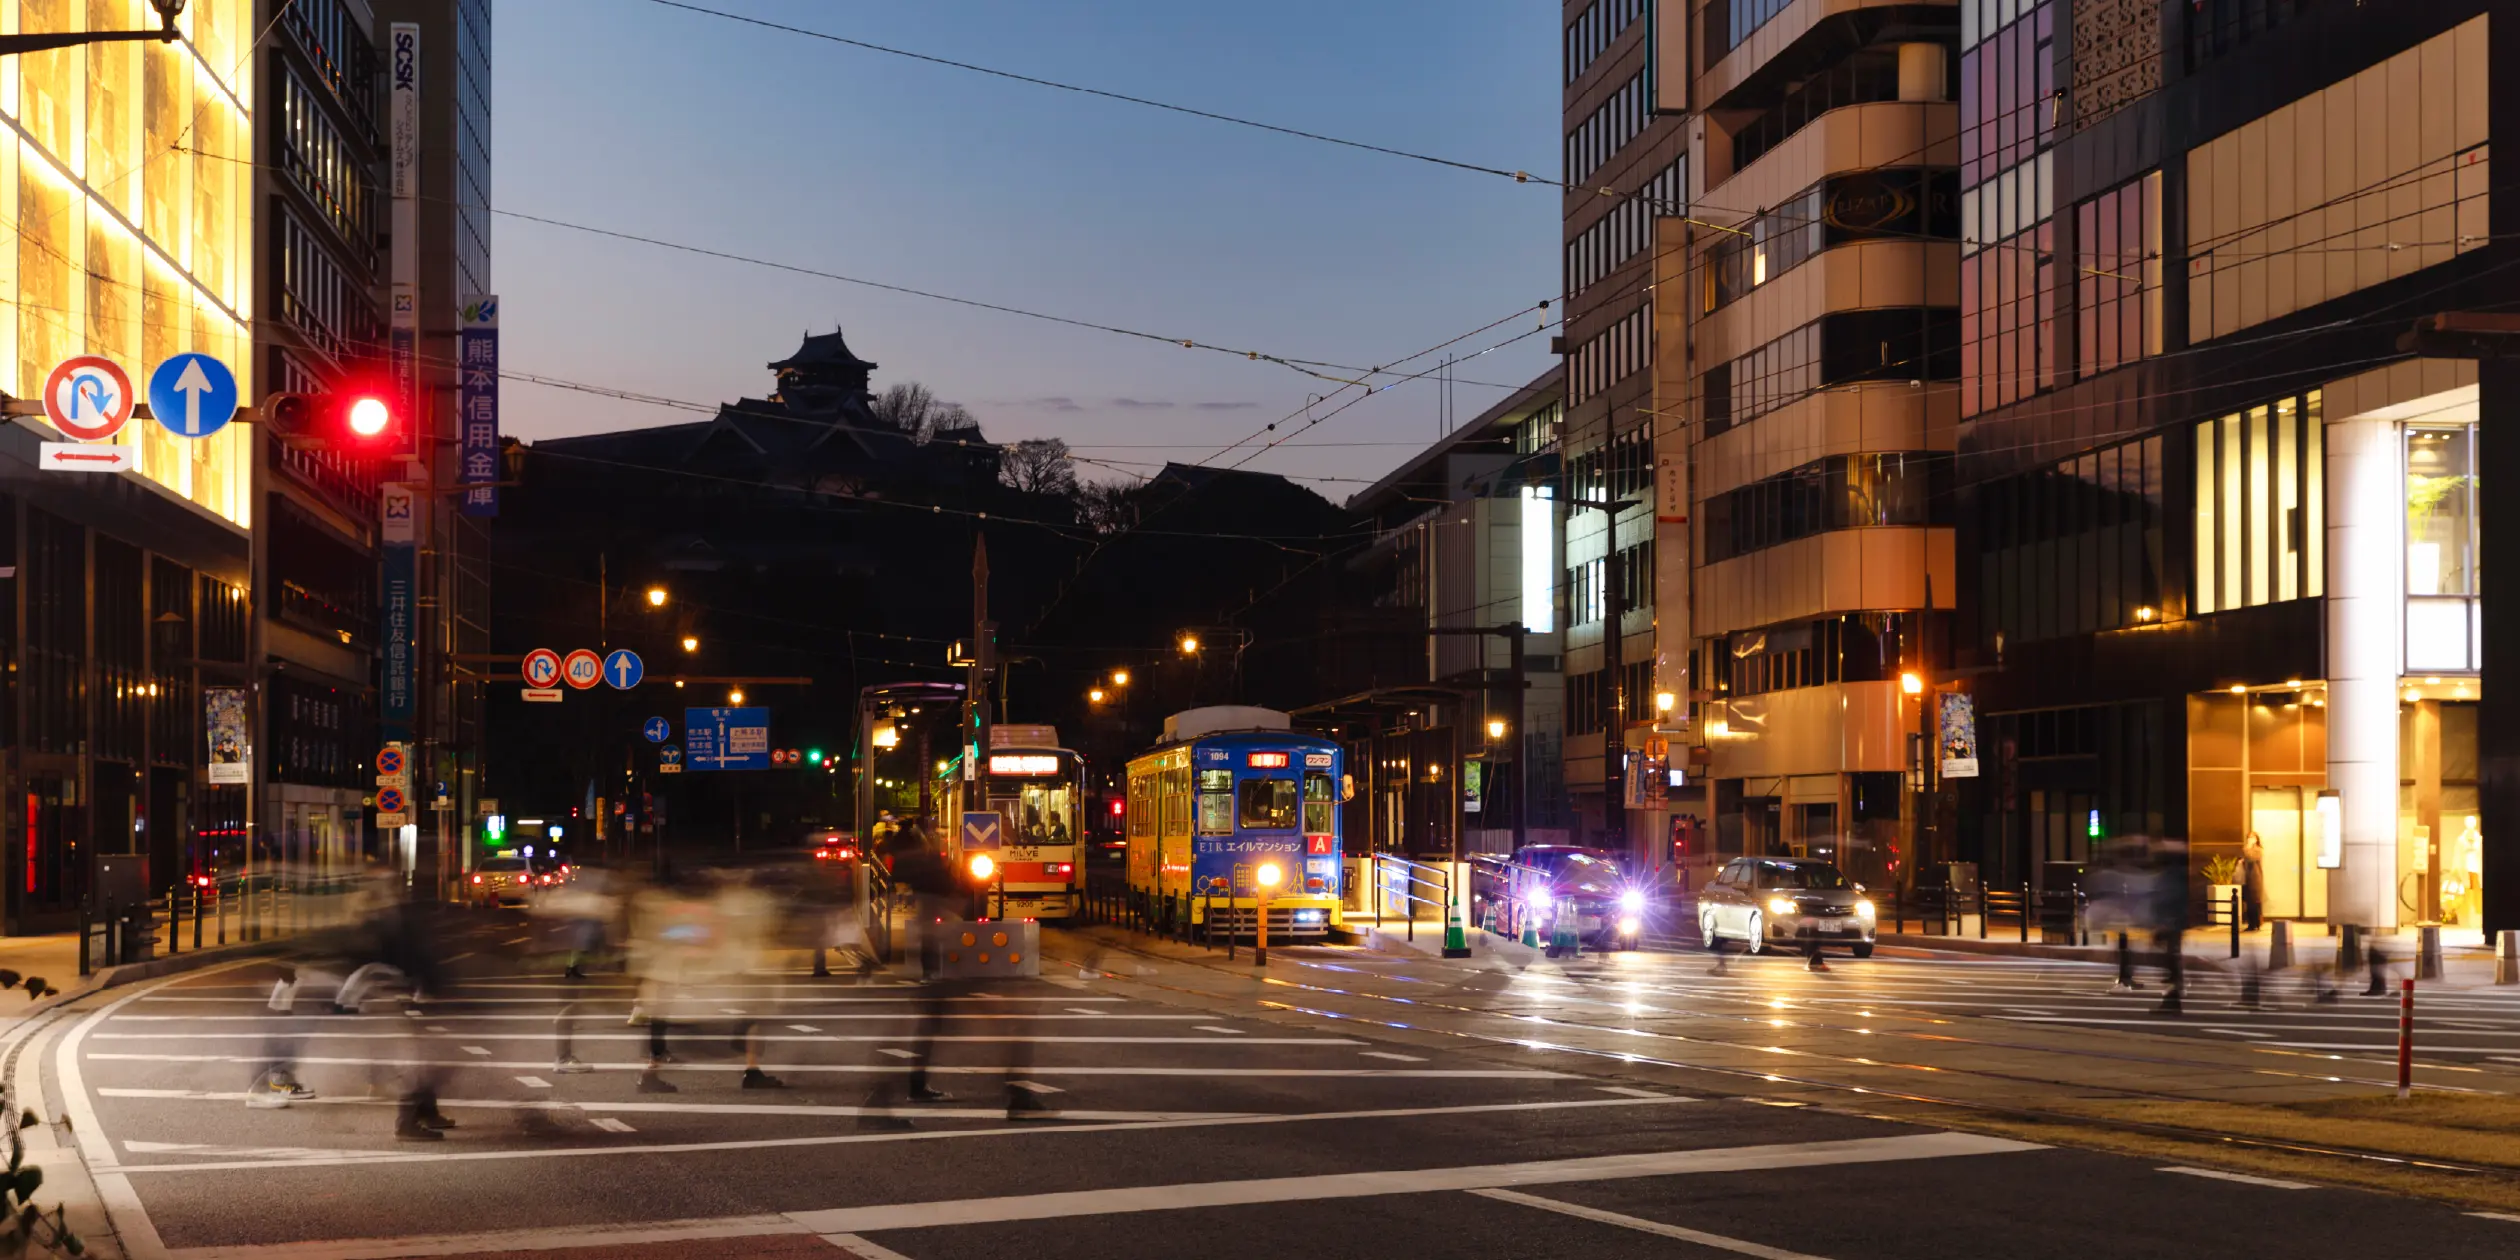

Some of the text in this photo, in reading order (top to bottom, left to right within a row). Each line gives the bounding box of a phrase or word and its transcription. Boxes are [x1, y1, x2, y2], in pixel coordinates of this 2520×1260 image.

[395, 32, 414, 91] SCSK
[467, 339, 494, 506] 熊本信用金庫
[389, 580, 406, 708] 三井住友信託銀行
[572, 661, 594, 678] 40
[1210, 752, 1229, 761] 1094
[1199, 842, 1301, 852] EIR エイルマンション
[1315, 837, 1326, 851] A
